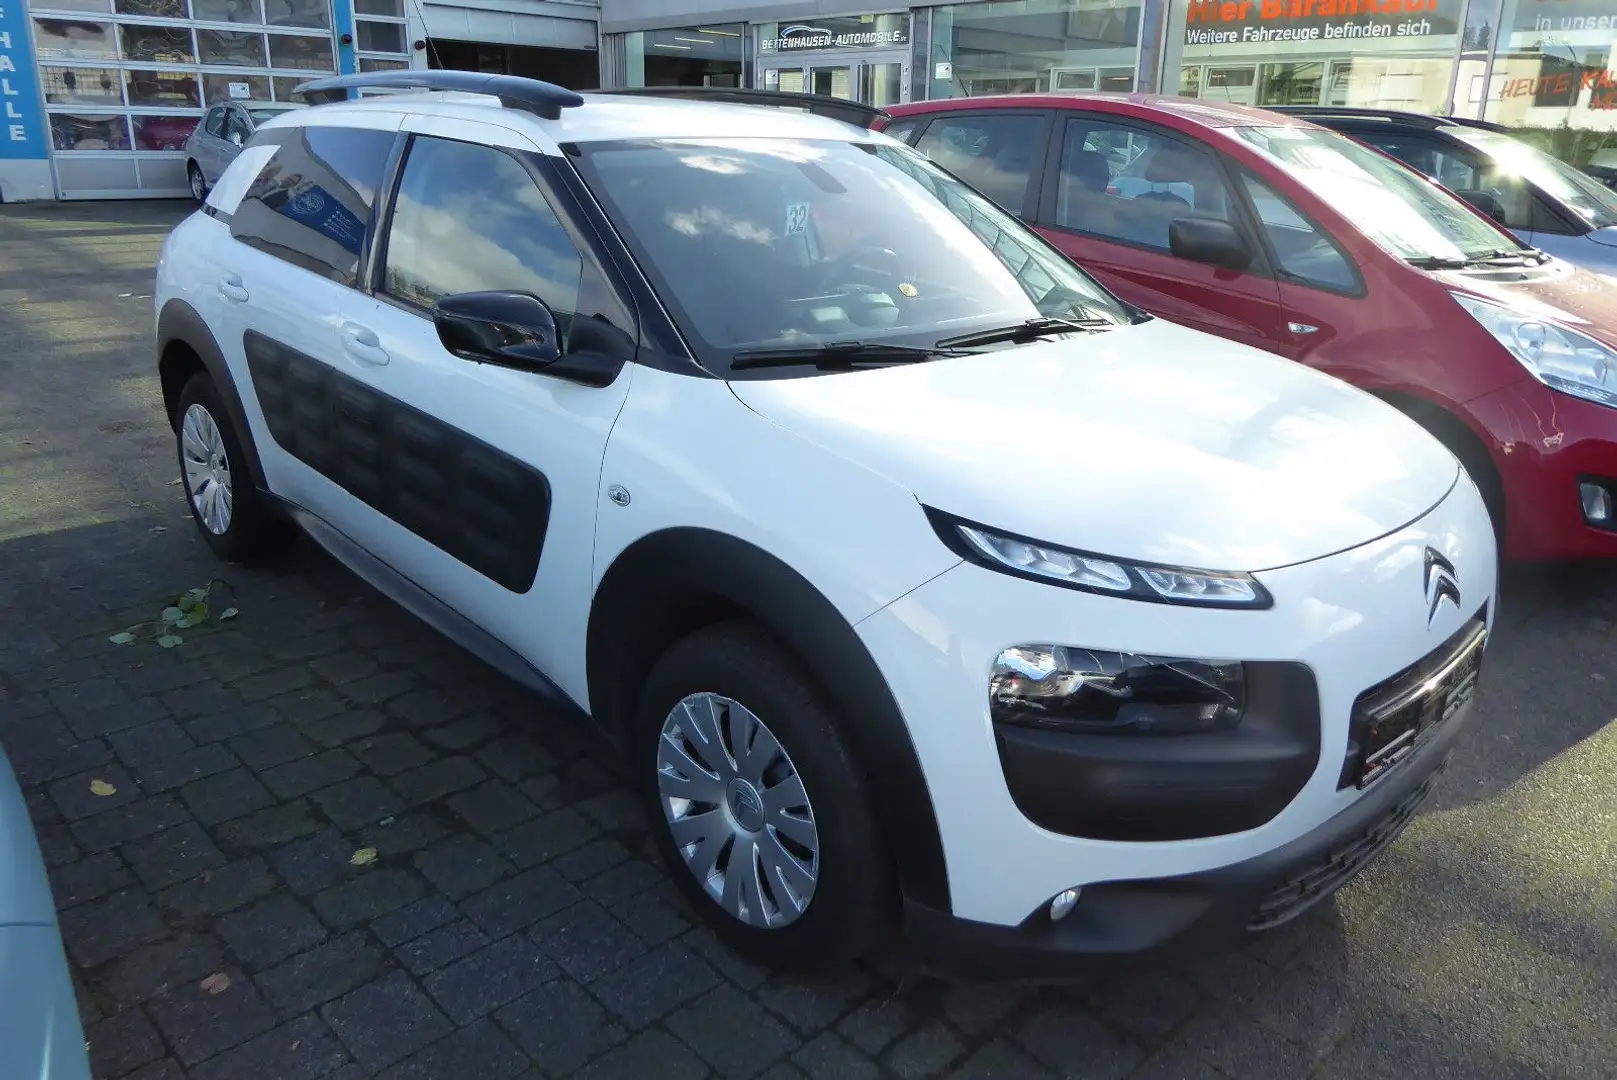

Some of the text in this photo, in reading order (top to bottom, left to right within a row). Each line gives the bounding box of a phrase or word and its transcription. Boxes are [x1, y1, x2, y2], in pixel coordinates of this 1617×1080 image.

[1187, 0, 1253, 24] Hier
[1535, 13, 1552, 32] in
[1187, 18, 1431, 44] Weitere Fahrzeuge befinden sich
[1499, 72, 1572, 98] HEUTE
[788, 205, 807, 234] 32
